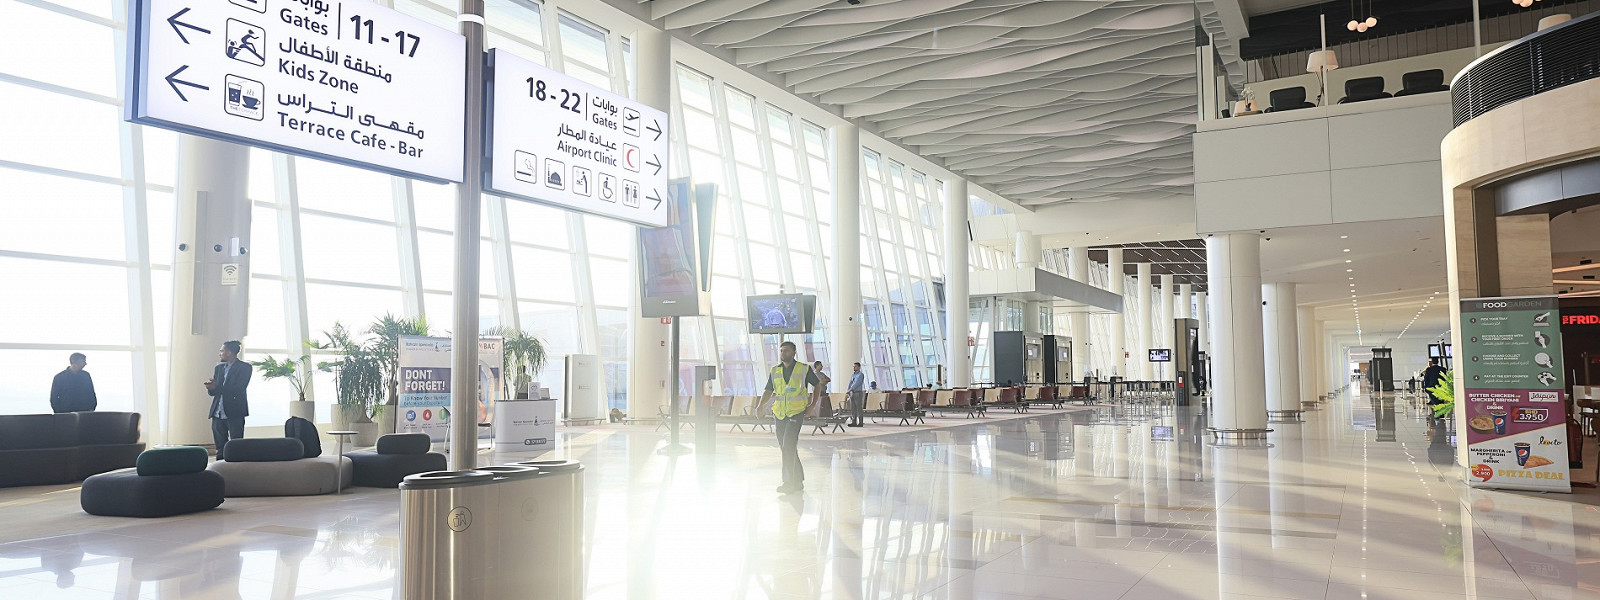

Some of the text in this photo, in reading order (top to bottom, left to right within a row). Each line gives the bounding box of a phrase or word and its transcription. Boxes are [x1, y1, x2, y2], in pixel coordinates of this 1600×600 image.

[280, 8, 328, 35] Gates
[350, 15, 373, 44] 11
[395, 30, 420, 58] 17
[279, 36, 392, 83] منطقة الأطفال
[279, 58, 358, 93] Kids Zone
[526, 76, 546, 101] 18
[560, 88, 581, 114] 22
[592, 97, 618, 117] بوابات
[277, 111, 345, 140] Terrace
[351, 130, 386, 150] Cafe
[398, 140, 423, 158] Bar
[592, 113, 617, 130] Gates
[557, 123, 617, 151] عيادة المطار
[557, 140, 617, 167] Airport Clinic
[1569, 314, 1600, 325] FRID
[404, 380, 445, 391] FORGET!
[405, 369, 432, 380] DONT
[1519, 413, 1544, 421] 3.950
[1498, 469, 1565, 480] PIZZA DEAL
